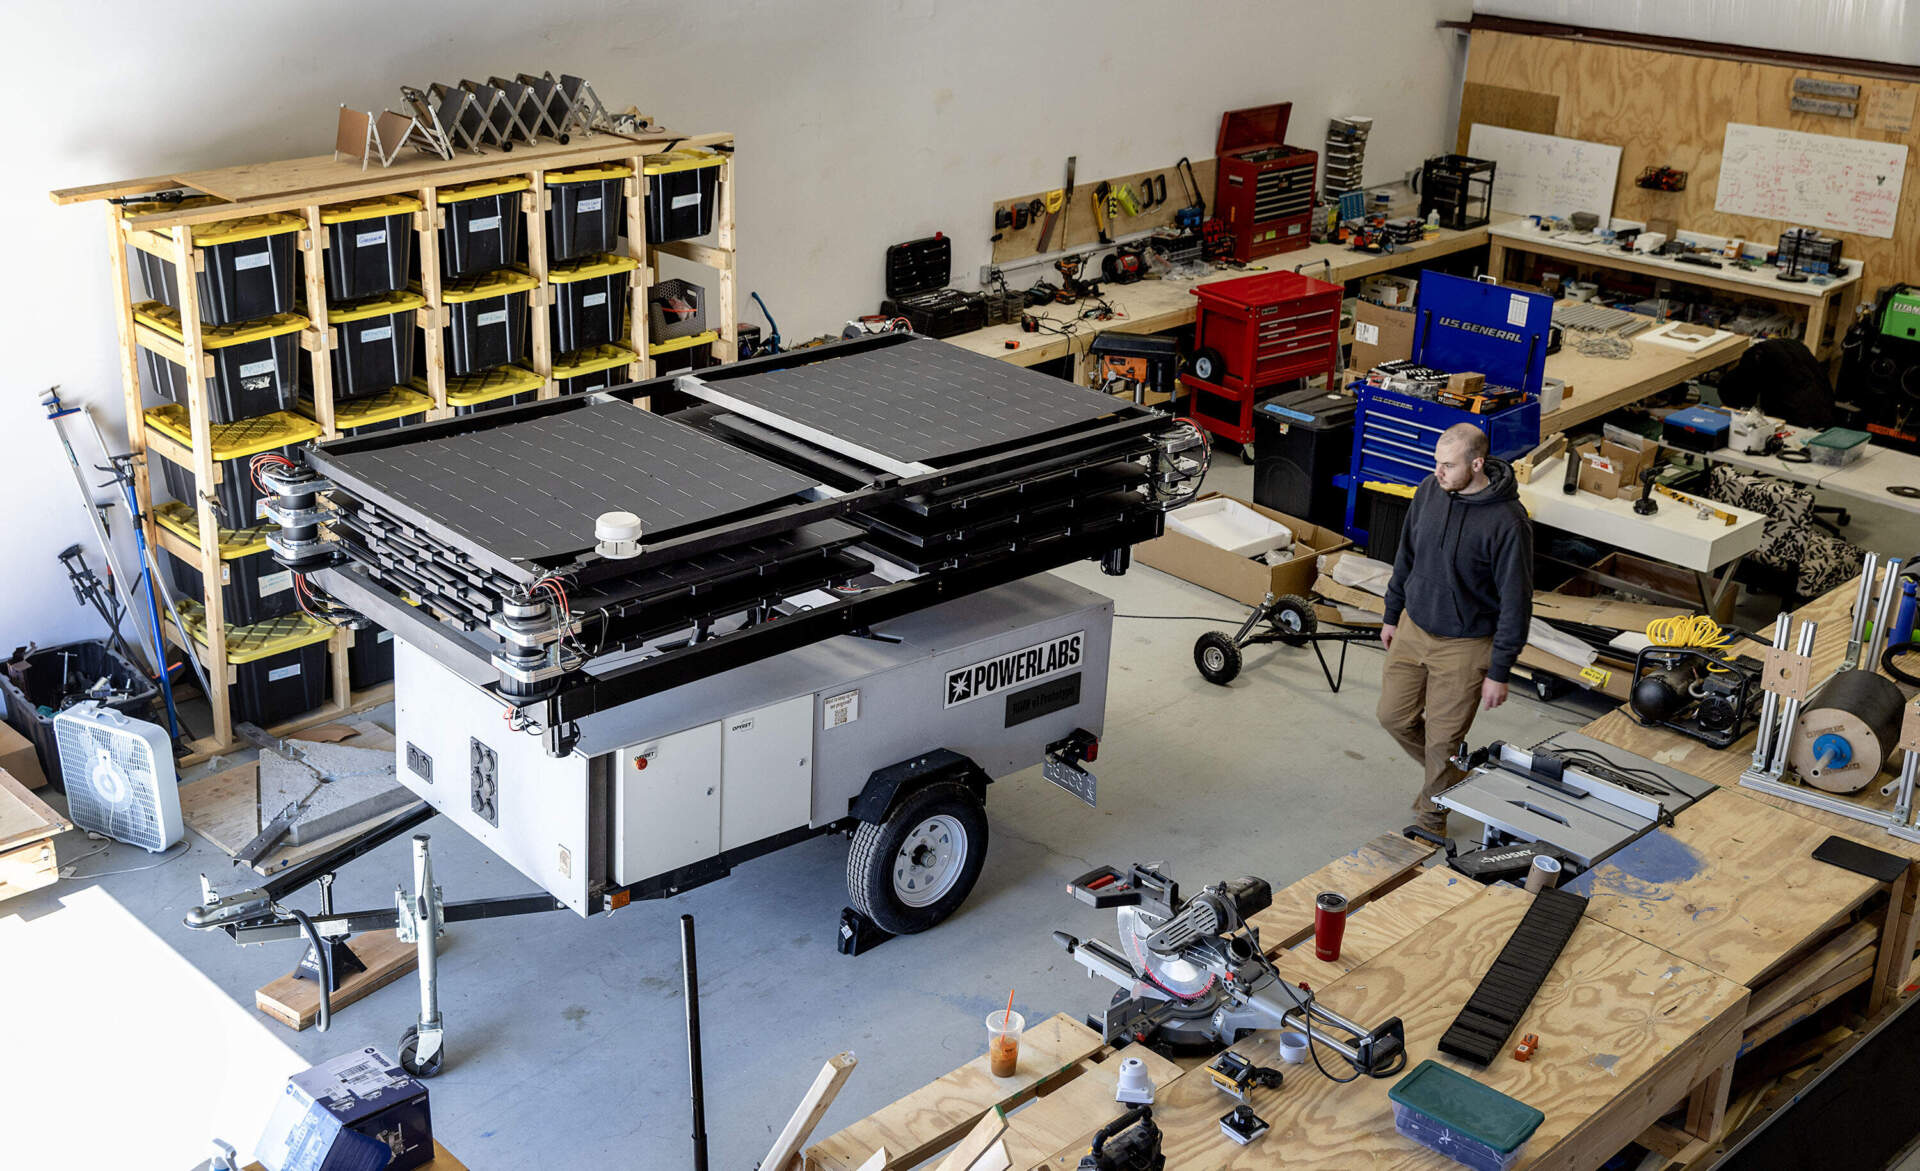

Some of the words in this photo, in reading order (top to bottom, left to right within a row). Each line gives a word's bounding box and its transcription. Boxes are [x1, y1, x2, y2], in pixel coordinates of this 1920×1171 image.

[1461, 322, 1522, 343] GENERAL
[973, 635, 1081, 696] POWERLABS
[1494, 849, 1533, 862] HUSKY
